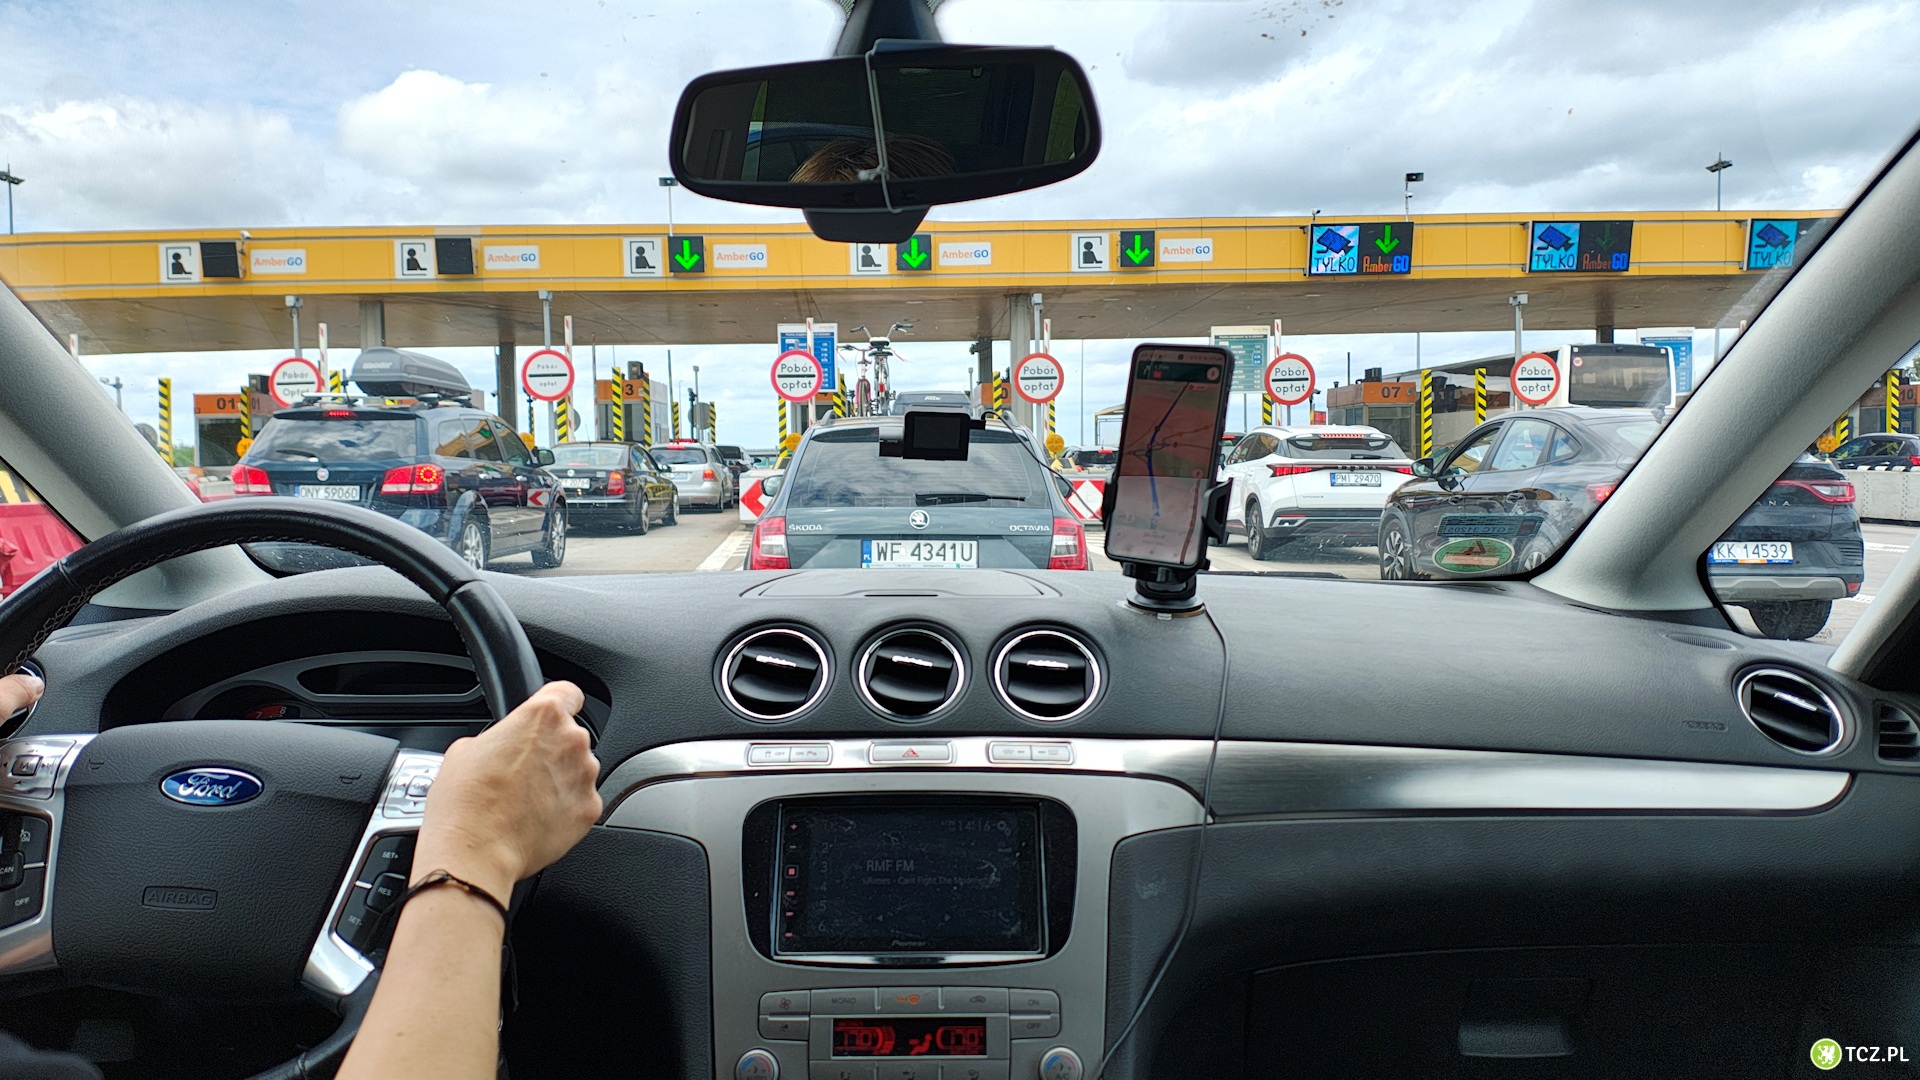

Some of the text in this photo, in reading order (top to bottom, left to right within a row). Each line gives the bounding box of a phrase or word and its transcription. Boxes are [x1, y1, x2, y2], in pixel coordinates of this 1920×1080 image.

[942, 249, 989, 259] AmberGO
[1162, 245, 1210, 255] AmberGO
[254, 257, 303, 267] AmberGO
[488, 253, 537, 263] AmberGO
[717, 252, 764, 261] AmberGO
[1535, 254, 1575, 268] TYLKO
[1753, 251, 1792, 266] TYLKO
[1315, 257, 1356, 272] TYLKO
[781, 363, 812, 373] Pobór
[1023, 365, 1054, 375] Pobór
[1275, 367, 1306, 377] Pobór
[1521, 366, 1552, 375] Pobór
[781, 380, 812, 391] opłat
[1024, 382, 1054, 393] opłat
[1275, 383, 1305, 395] opłat
[1521, 383, 1551, 395] opłat
[1381, 386, 1401, 398] 07
[1900, 388, 1914, 400] 10
[217, 397, 236, 410] 01
[1354, 475, 1380, 483] 29470
[324, 487, 358, 499] 59060
[788, 523, 823, 532] ŠKODA
[1009, 524, 1050, 532] OCTAVIA
[877, 542, 902, 561] WF
[910, 542, 973, 562] 4341U
[1716, 543, 1788, 559] KK 14539
[256, 711, 263, 719] 7
[279, 706, 287, 714] 8
[178, 773, 243, 800] Ford
[866, 859, 915, 872] RMF FM
[377, 887, 392, 896] RES
[14, 896, 30, 907] OFF
[146, 891, 214, 907] AIRBAG
